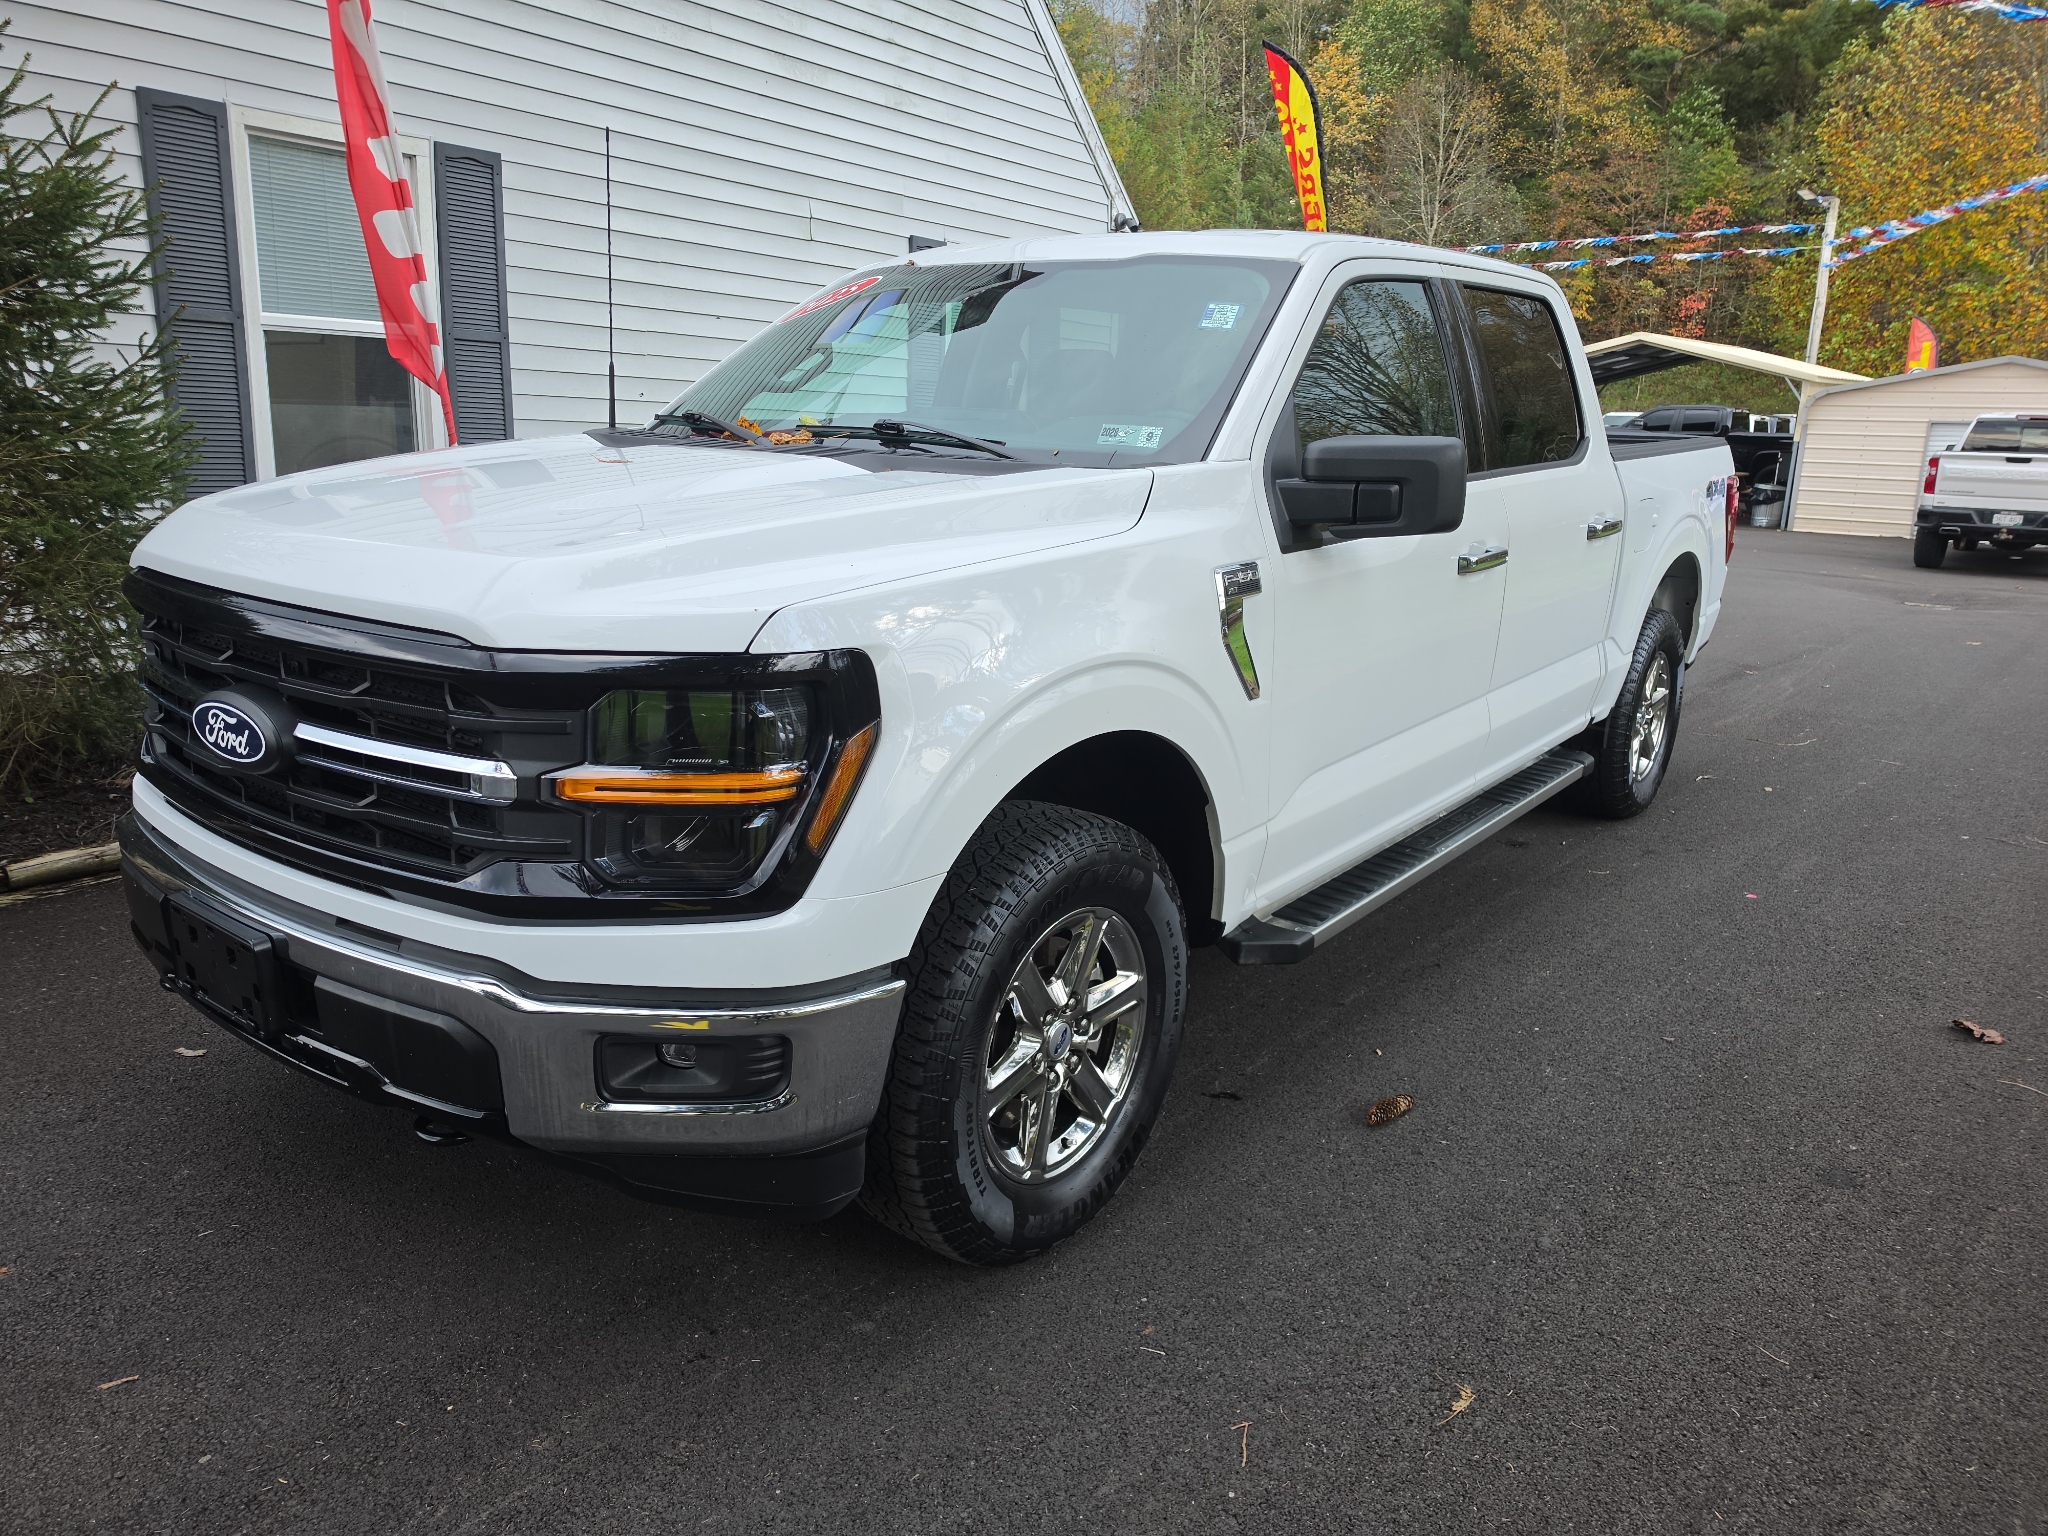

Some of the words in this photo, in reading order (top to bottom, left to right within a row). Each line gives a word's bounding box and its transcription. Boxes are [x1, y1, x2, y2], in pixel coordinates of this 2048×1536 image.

[205, 708, 250, 755] Ford
[966, 1101, 987, 1198] TERRITORY
[1022, 1122, 1149, 1238] WRANGLER
